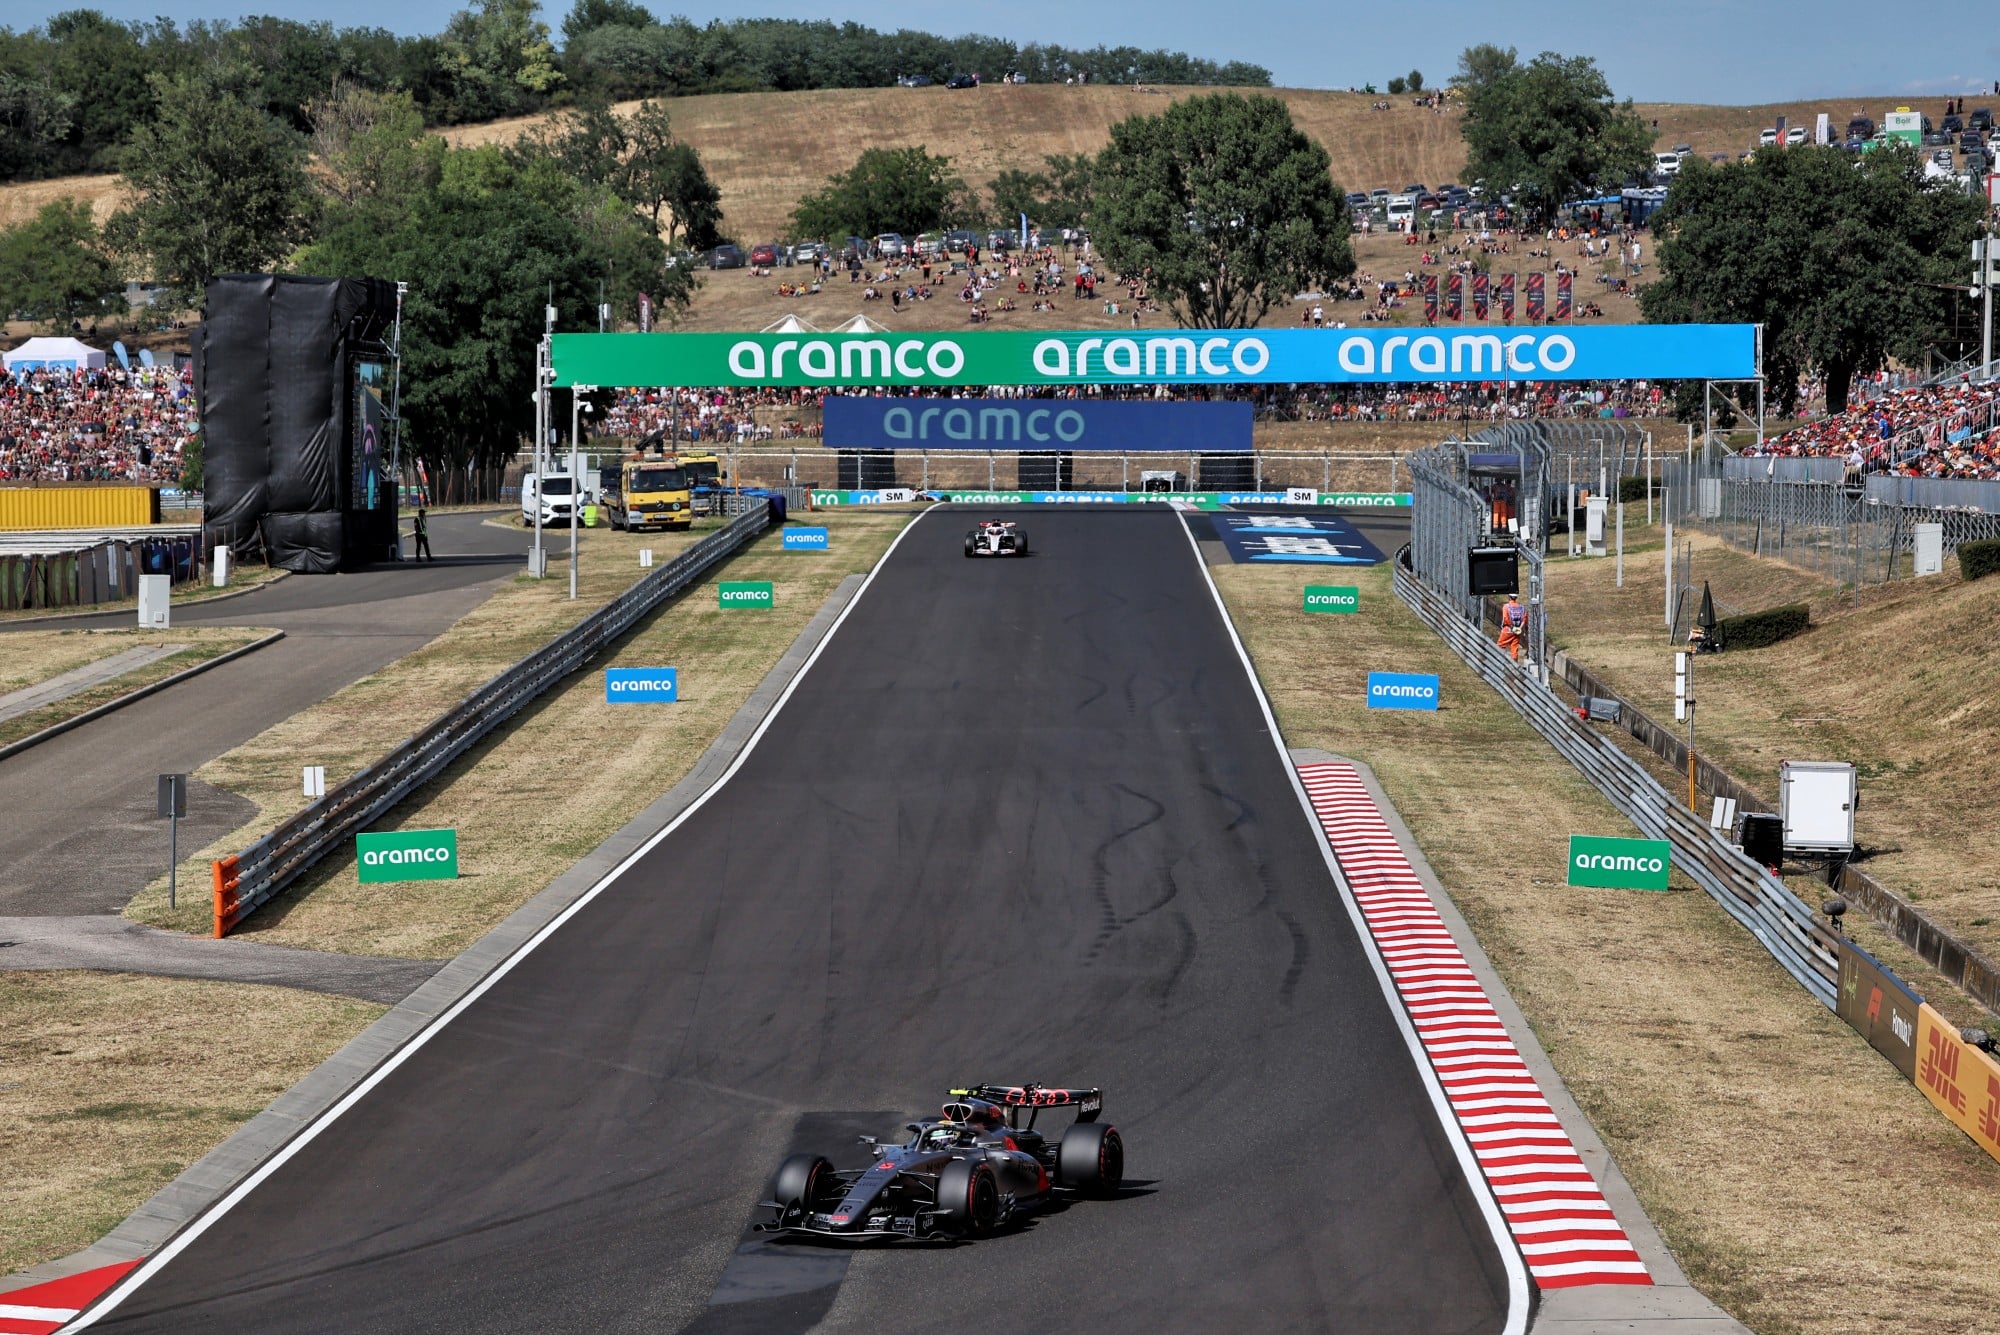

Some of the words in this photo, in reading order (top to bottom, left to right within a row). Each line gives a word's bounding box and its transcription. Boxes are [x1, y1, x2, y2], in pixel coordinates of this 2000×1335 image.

[728, 340, 965, 378] aramco
[1033, 338, 1270, 376] aramco
[1338, 334, 1576, 374] aramco
[883, 407, 1085, 442] aramco
[886, 492, 903, 501] SM
[1294, 492, 1311, 501] SM
[785, 534, 825, 543] aramco
[722, 590, 769, 600] aramco
[1308, 594, 1355, 605] aramco
[610, 679, 673, 692] aramco
[1372, 684, 1434, 698] aramco
[363, 847, 450, 865] aramco
[1575, 853, 1663, 873] aramco
